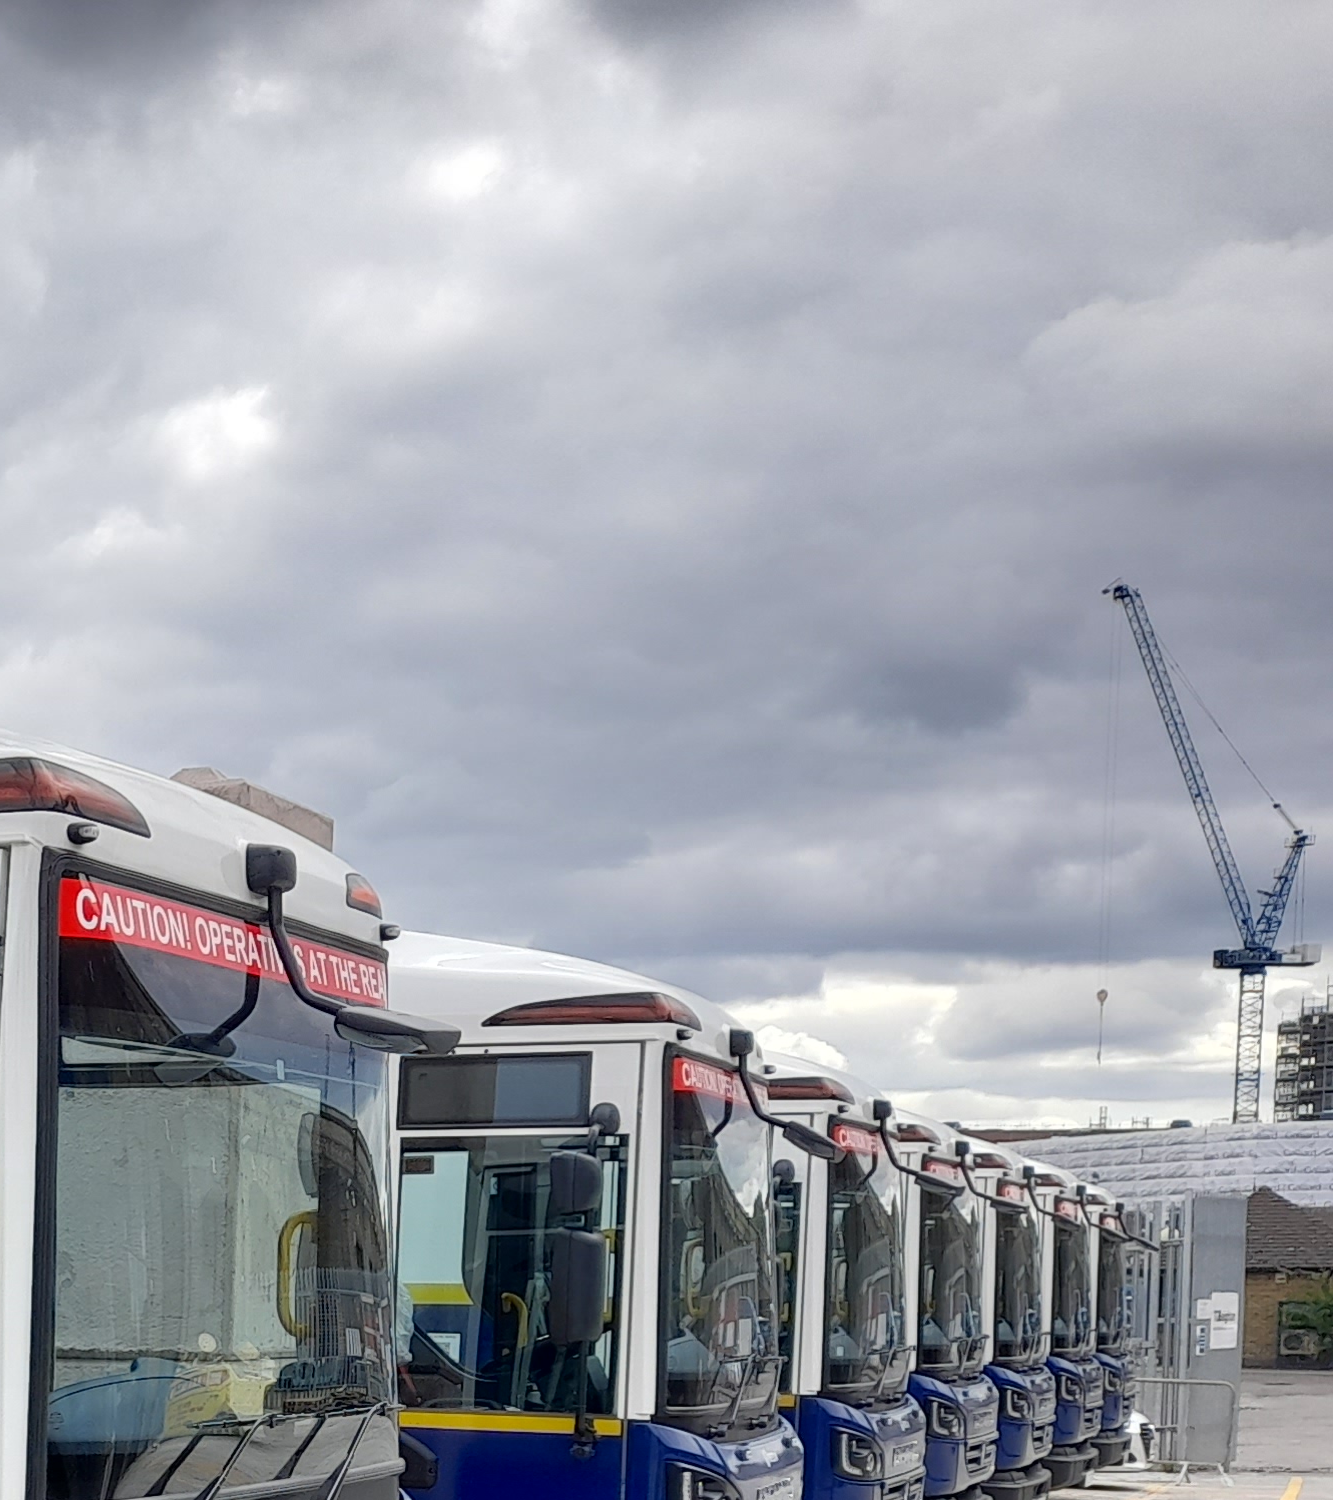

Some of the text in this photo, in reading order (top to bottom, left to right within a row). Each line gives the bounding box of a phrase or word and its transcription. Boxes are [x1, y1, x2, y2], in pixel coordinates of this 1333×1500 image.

[76, 888, 192, 950] CAUTION!
[309, 951, 330, 986] AT
[331, 956, 358, 995] THE
